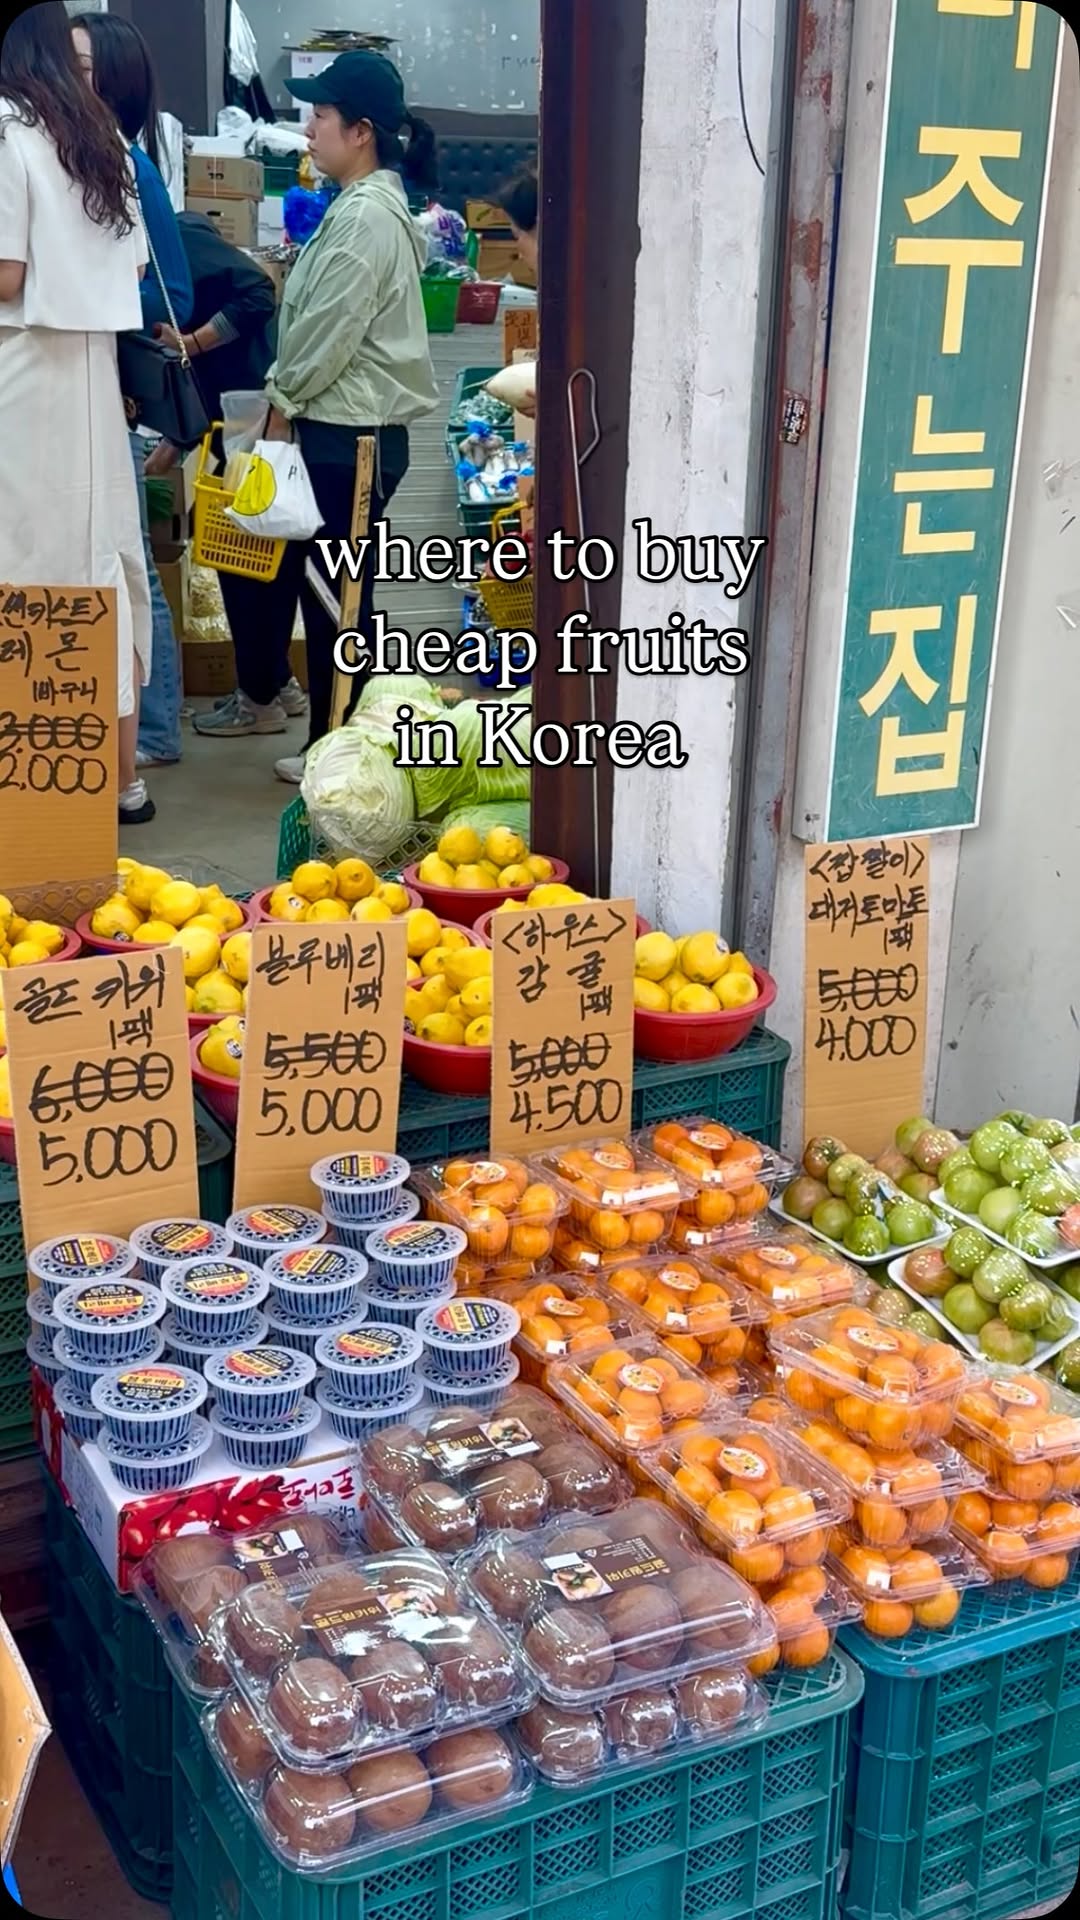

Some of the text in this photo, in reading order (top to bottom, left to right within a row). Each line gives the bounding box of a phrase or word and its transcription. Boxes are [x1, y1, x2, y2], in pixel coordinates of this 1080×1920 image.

[809, 883, 929, 938] 대저토마토
[256, 931, 385, 986] 블루베리
[883, 922, 914, 955] 1팩
[344, 976, 382, 1014] 1팩
[580, 984, 613, 1021] 1팩
[109, 1006, 153, 1050] 1팩
[28, 1052, 174, 1124] 6,000
[255, 1086, 382, 1137] 5,000
[38, 1117, 178, 1186] 5,000
